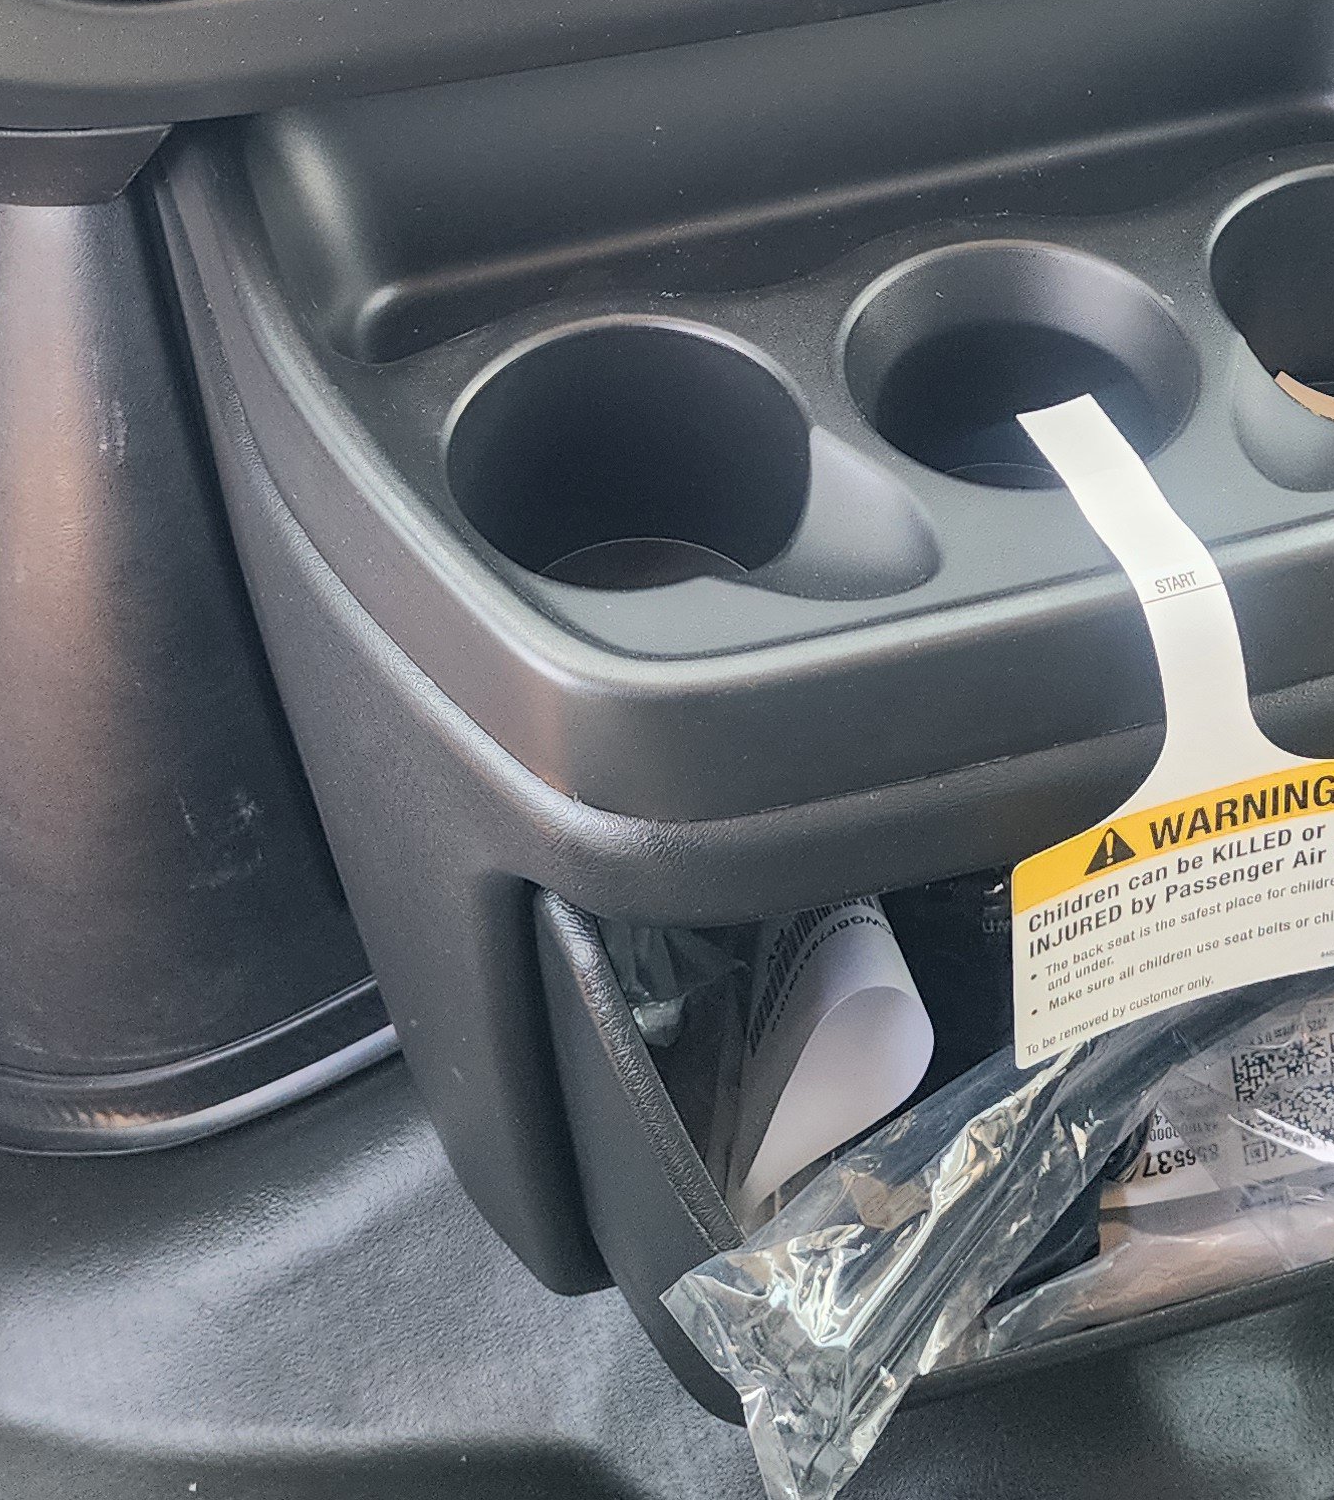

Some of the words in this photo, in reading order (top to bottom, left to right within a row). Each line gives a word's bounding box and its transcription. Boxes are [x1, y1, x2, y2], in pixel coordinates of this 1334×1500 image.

[1154, 571, 1196, 595] START
[1029, 883, 1120, 933] Children
[1128, 866, 1167, 890] can
[1177, 855, 1203, 875] be
[1212, 829, 1292, 865] KILLED
[1302, 822, 1327, 842] or
[1029, 904, 1122, 959] INJURED
[1131, 894, 1157, 915] by
[1165, 857, 1285, 903] Passenger
[1293, 847, 1327, 869] Air
[1045, 959, 1068, 977] The
[1073, 944, 1104, 964] back
[1107, 931, 1136, 950] seat
[1139, 925, 1151, 938] is
[1155, 917, 1176, 932] the
[1180, 903, 1222, 924] safest
[1225, 892, 1262, 912] place
[1267, 886, 1287, 900] for
[1047, 973, 1071, 992] and
[1075, 956, 1115, 978] under.
[1048, 991, 1083, 1012] Make
[1087, 974, 1115, 994] sure
[1119, 965, 1135, 981] all
[1139, 947, 1192, 974] children
[1196, 939, 1220, 954] use
[1224, 928, 1253, 947] seat
[1258, 921, 1291, 937] belts
[1295, 916, 1310, 929] or
[1025, 1043, 1039, 1056] To
[1042, 1034, 1056, 1048] be
[1059, 1011, 1109, 1041] removed
[1112, 1003, 1126, 1018] by
[1129, 983, 1184, 1012] customer
[1187, 974, 1215, 992] only.
